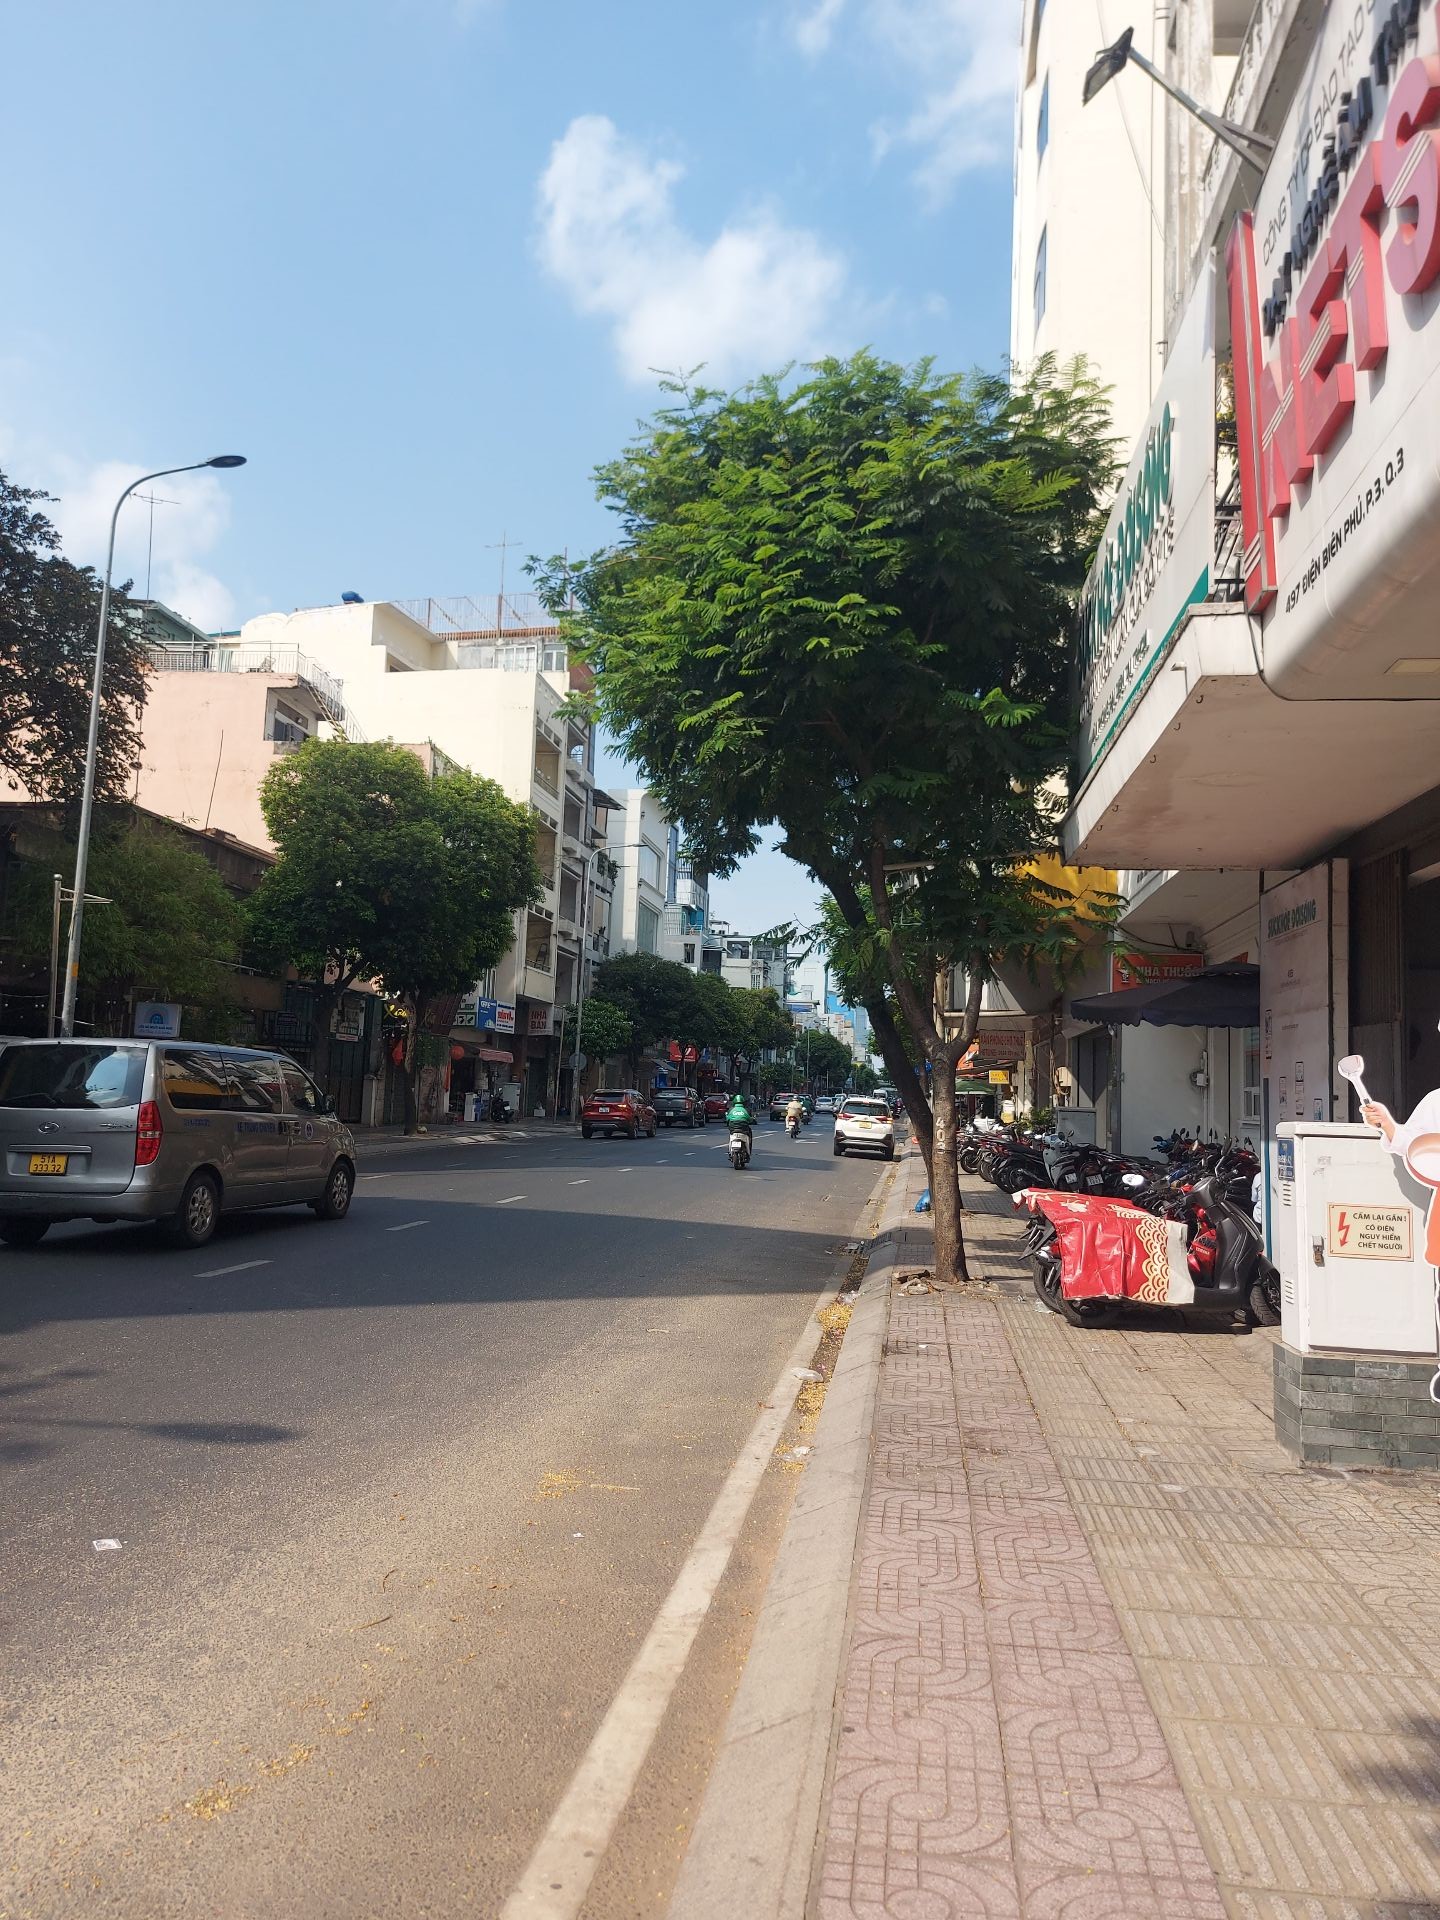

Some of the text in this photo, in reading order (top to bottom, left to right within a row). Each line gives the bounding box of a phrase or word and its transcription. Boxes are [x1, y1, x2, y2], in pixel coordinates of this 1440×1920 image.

[1263, 195, 1288, 266] CÔNG
[1287, 160, 1300, 206] TY
[1313, 68, 1338, 140] ĐÀO
[1338, 4, 1364, 76] TẠO
[1260, 0, 1440, 517] NETS
[1286, 582, 1300, 613] 497
[1302, 556, 1320, 595] ĐIỆN
[1322, 527, 1341, 569] BIÊN
[1385, 448, 1404, 486] Q.3
[40, 1155, 56, 1164] 51A
[1353, 1211, 1370, 1220] CẤM
[1372, 1214, 1384, 1222] LẠI
[1377, 1225, 1395, 1233] ĐIỆN
[1382, 1233, 1400, 1241] HIỂM
[1358, 1241, 1376, 1249] CHẾT
